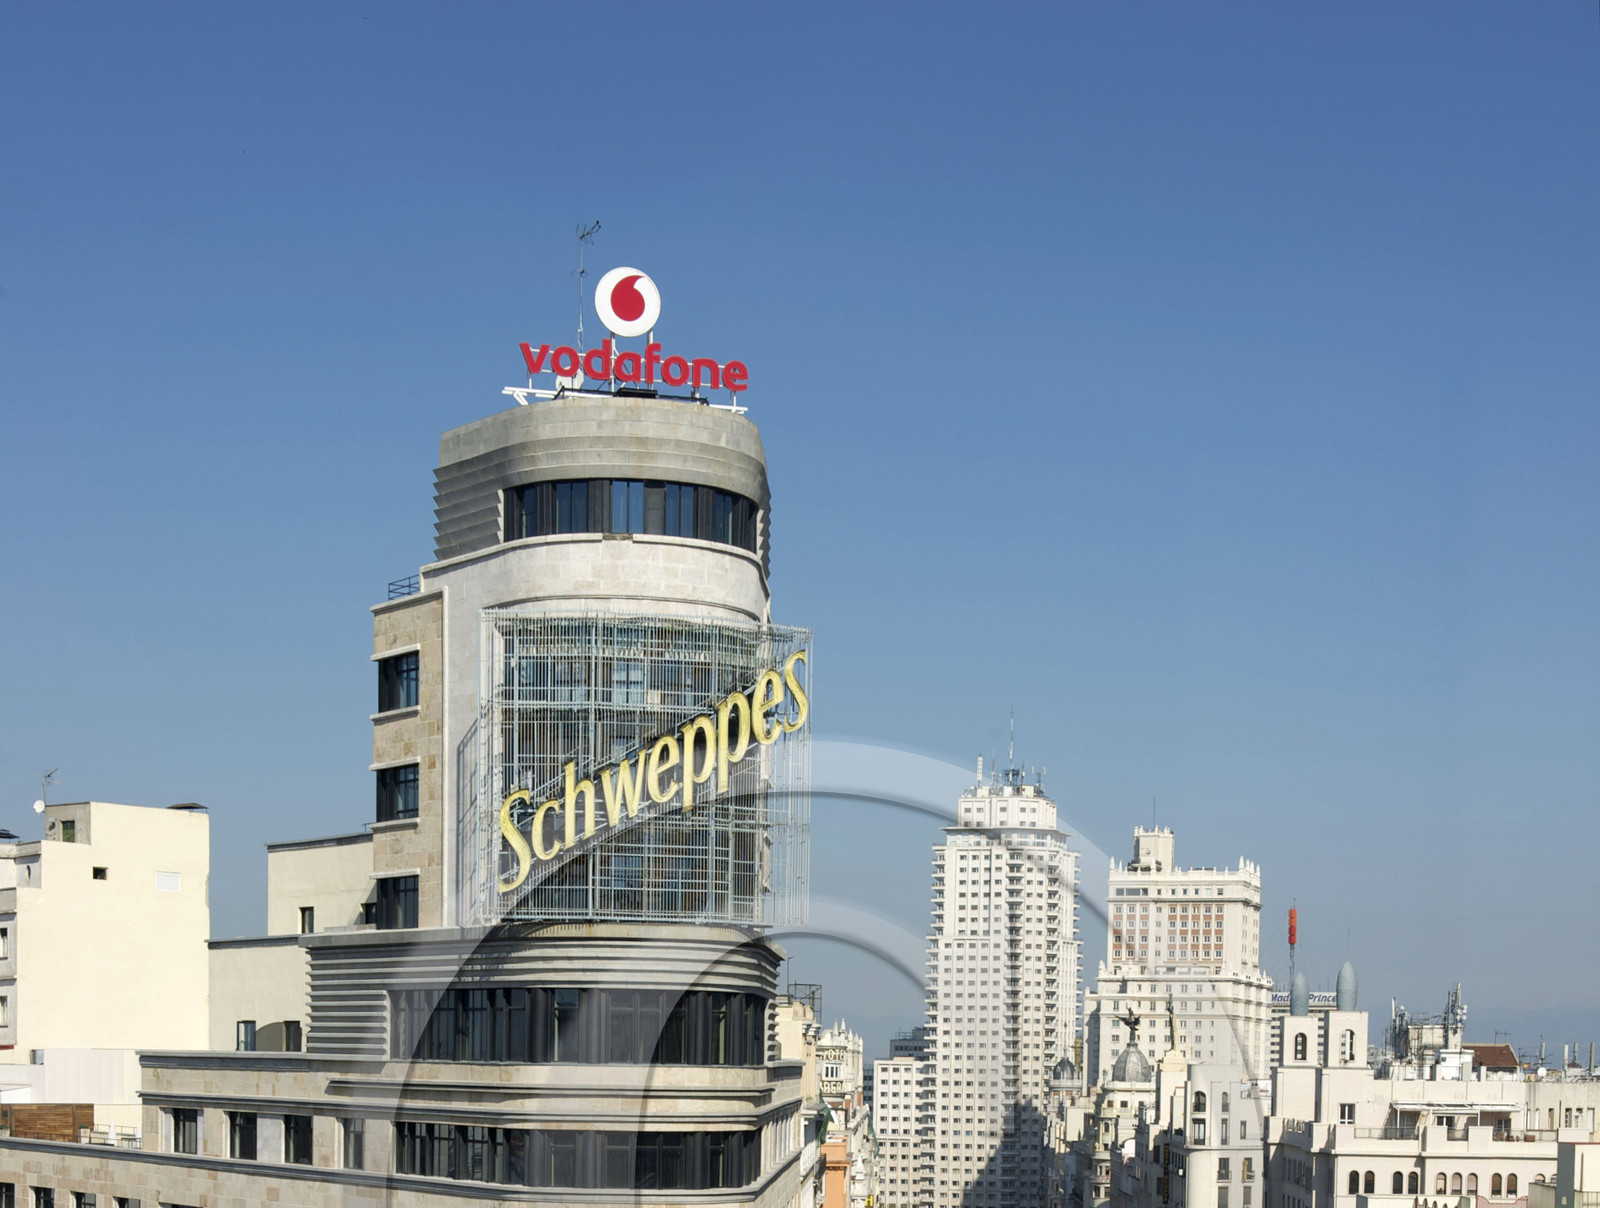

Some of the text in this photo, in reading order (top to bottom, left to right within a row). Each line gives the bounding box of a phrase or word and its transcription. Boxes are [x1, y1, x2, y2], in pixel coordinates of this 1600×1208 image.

[519, 338, 749, 391] vodafone
[497, 649, 808, 893] Schweppes
[1309, 993, 1337, 1002] Prince
